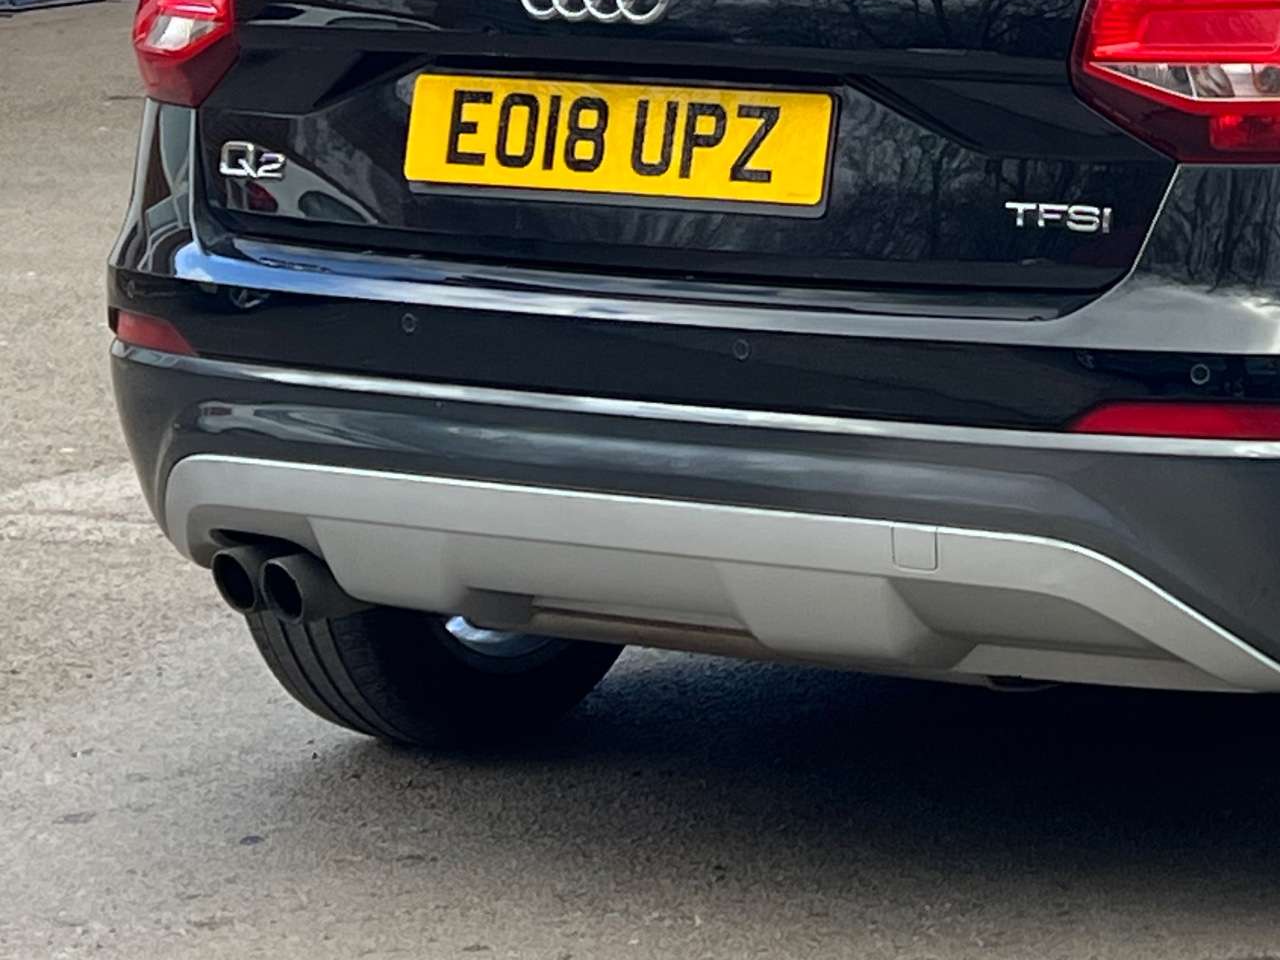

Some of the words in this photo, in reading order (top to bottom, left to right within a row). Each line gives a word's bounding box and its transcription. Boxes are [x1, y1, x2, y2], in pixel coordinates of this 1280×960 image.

[446, 89, 609, 173] EO18
[630, 98, 781, 183] UPZ
[220, 141, 286, 179] Q2
[1005, 201, 1112, 233] TFSI
